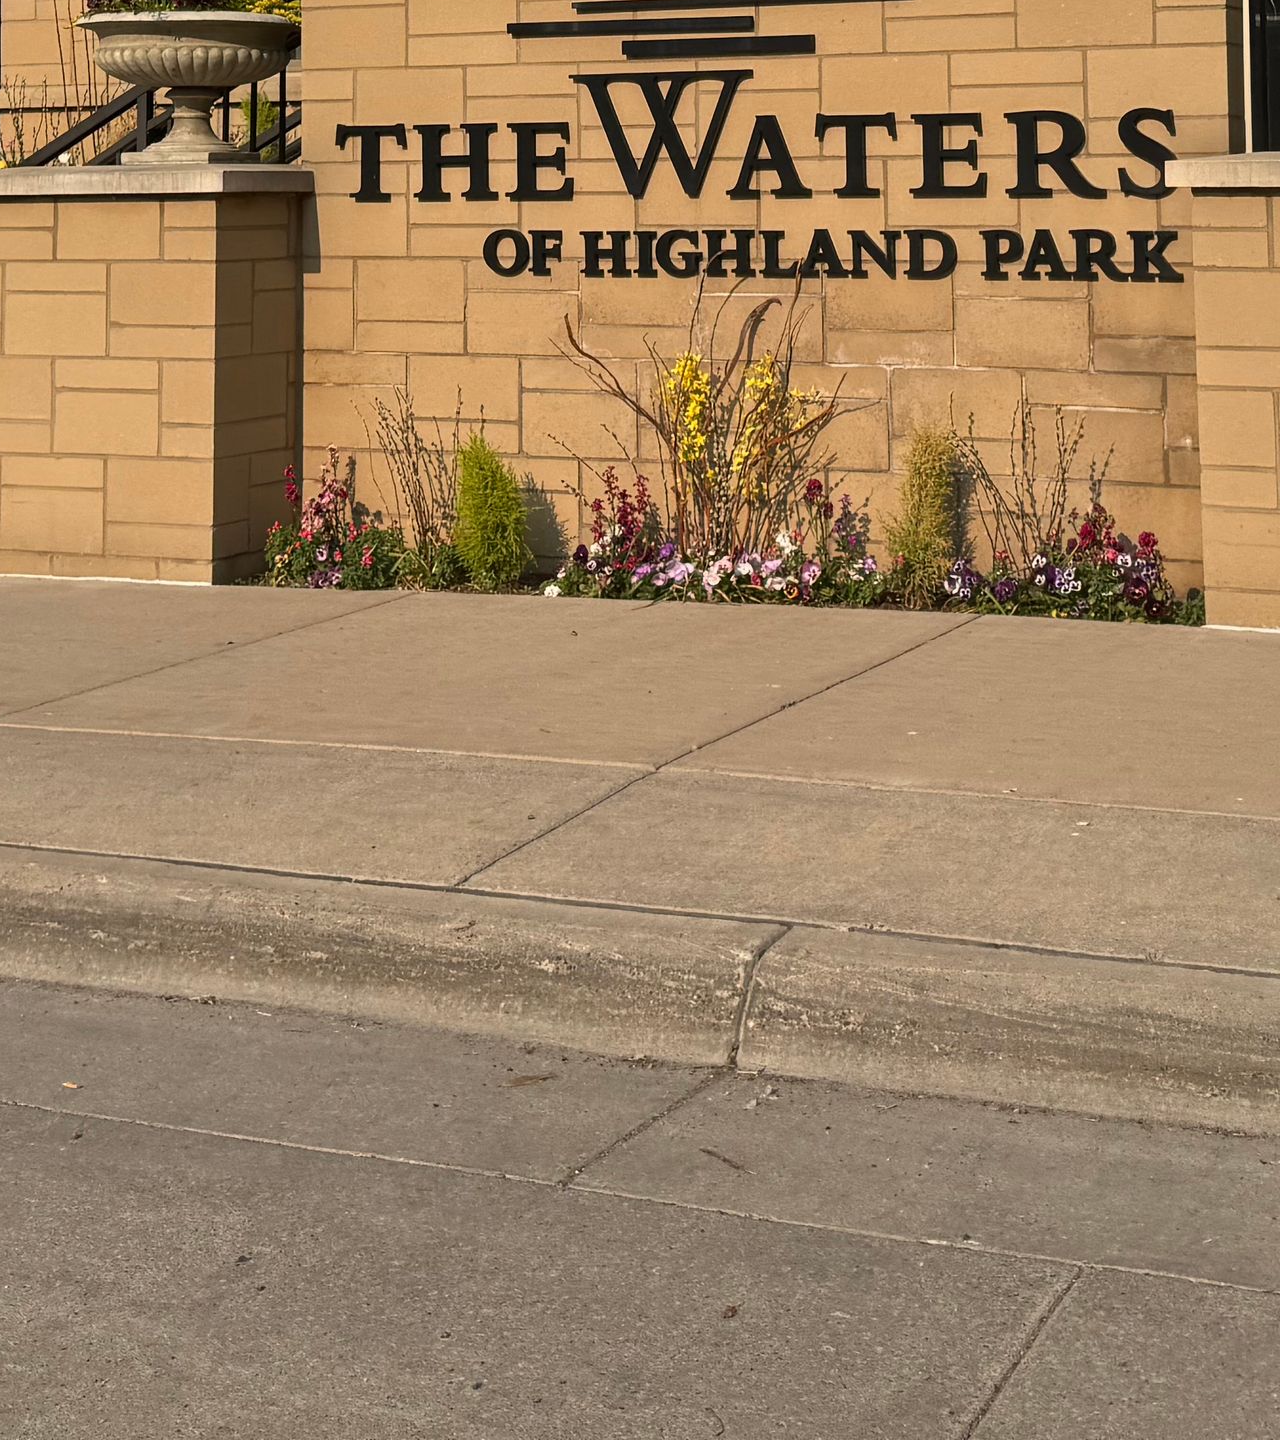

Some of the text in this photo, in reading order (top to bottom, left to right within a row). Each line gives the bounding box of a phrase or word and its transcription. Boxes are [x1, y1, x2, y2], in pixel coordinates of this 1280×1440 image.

[336, 70, 1176, 202] THE WATERS
[483, 229, 1184, 282] OF HIGHLAND PARK
